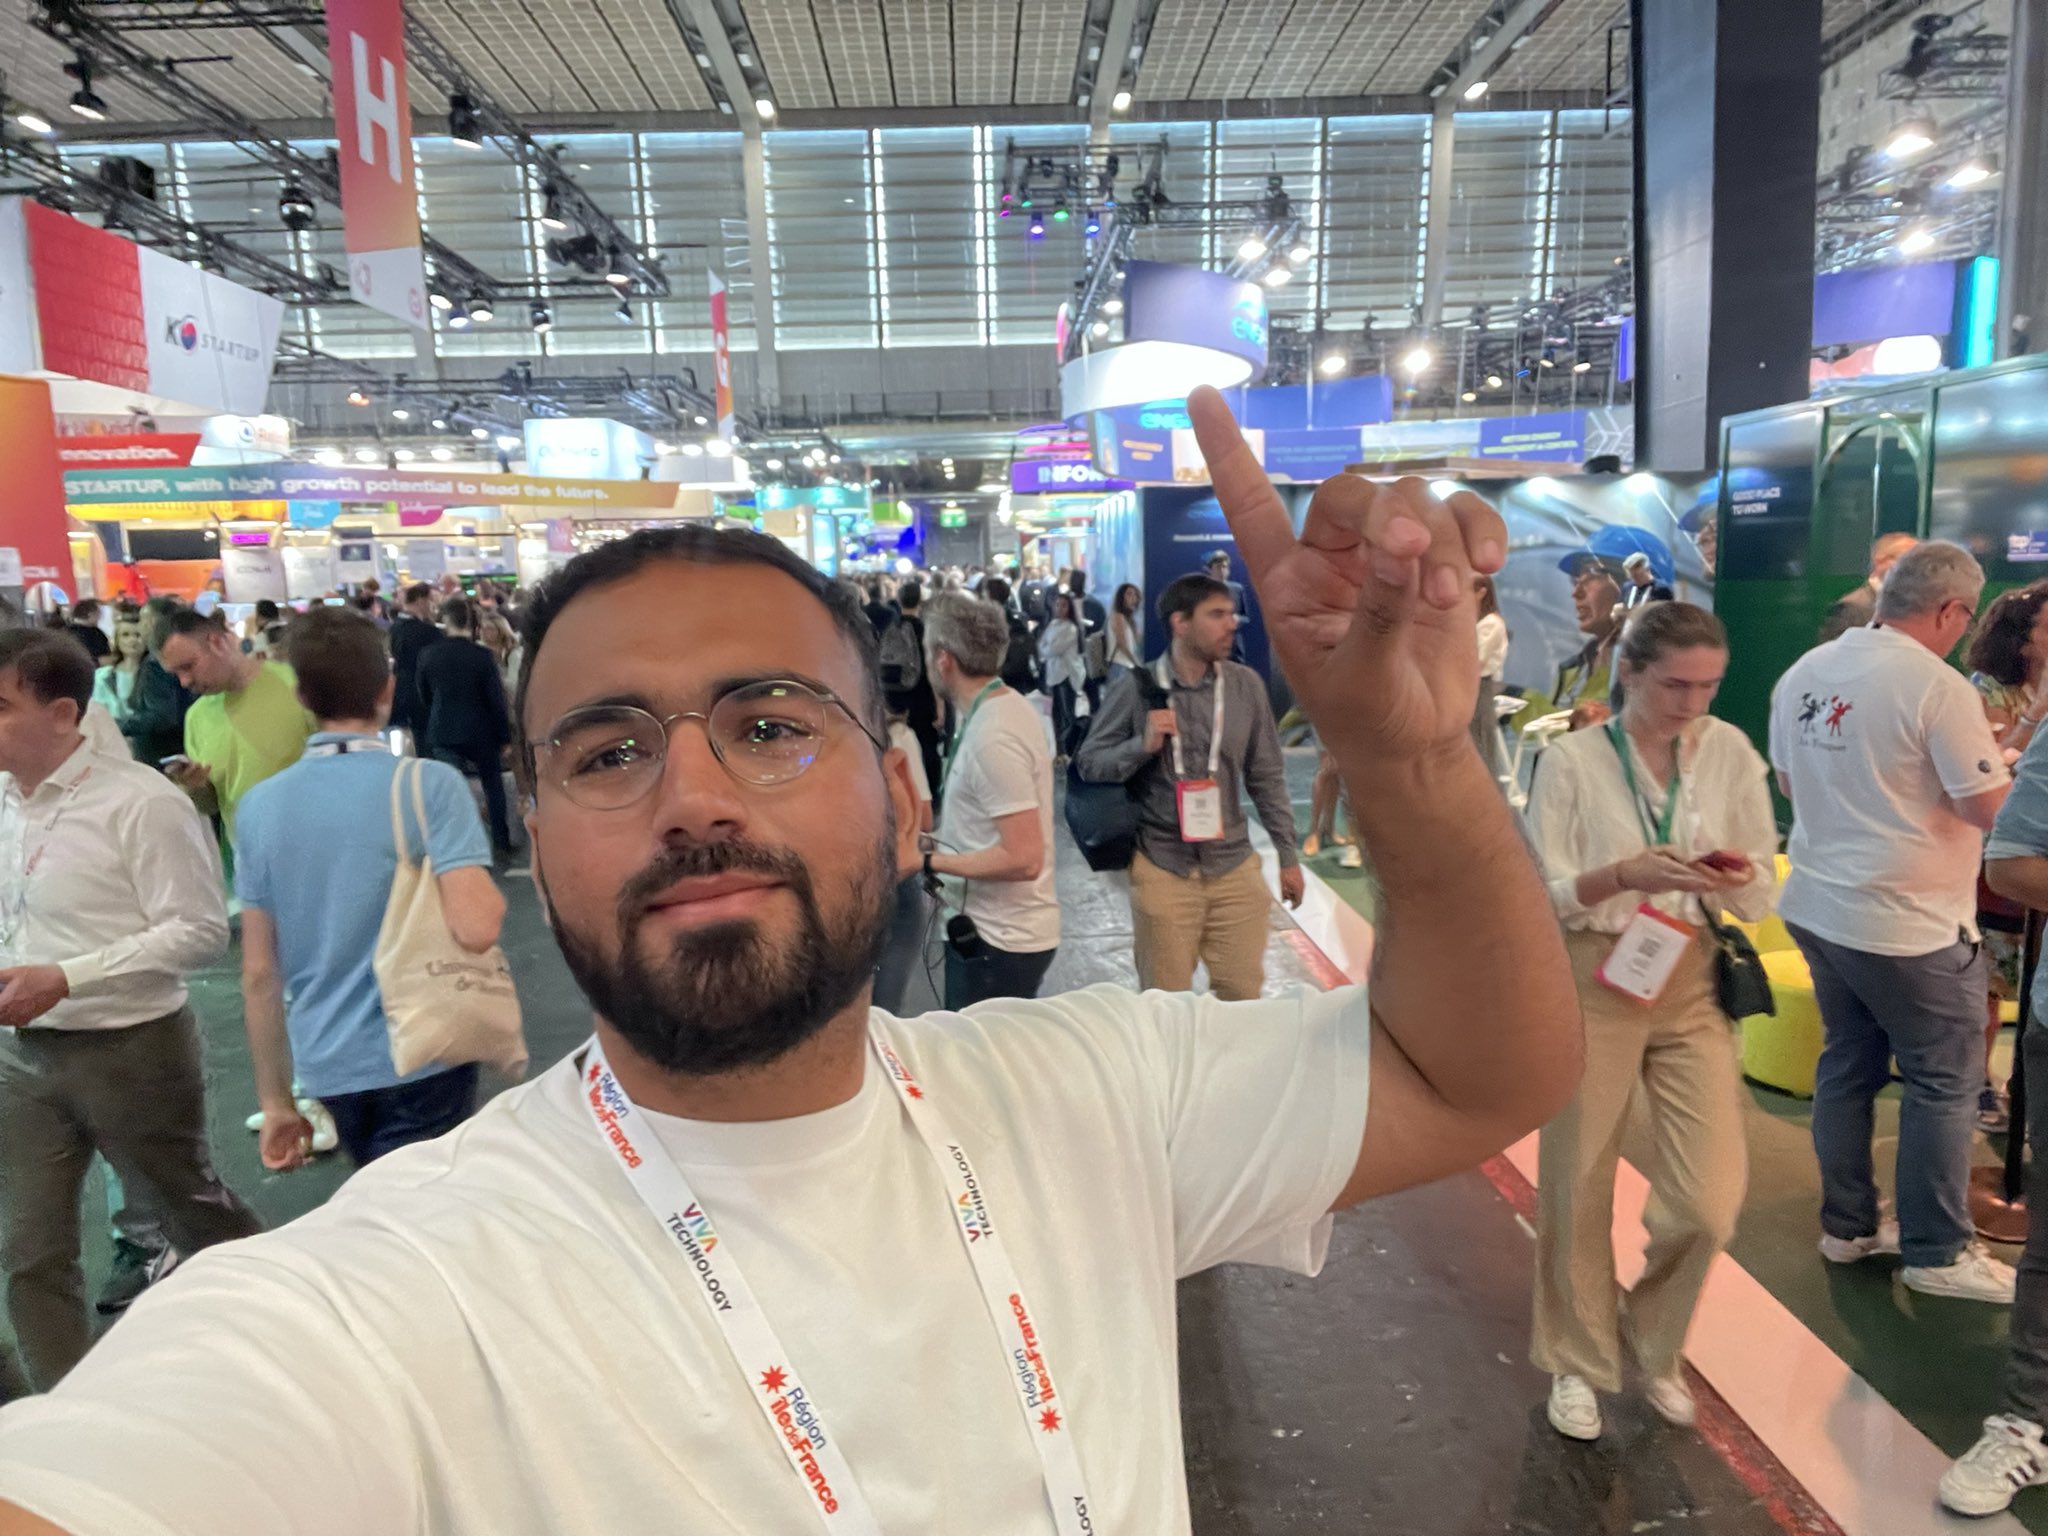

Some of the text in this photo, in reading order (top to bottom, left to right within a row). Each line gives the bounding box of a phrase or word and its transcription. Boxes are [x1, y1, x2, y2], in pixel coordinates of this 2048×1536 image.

[350, 31, 402, 184] H
[175, 478, 223, 492] with
[229, 476, 276, 494] high
[281, 477, 360, 494] growth
[365, 479, 452, 495] potential
[457, 482, 477, 494] to
[481, 483, 519, 496] lead
[524, 484, 550, 497] the
[556, 485, 609, 500] future.
[947, 1145, 994, 1239] TECHNOLOGY
[958, 1193, 980, 1243] VIVA
[683, 1202, 718, 1253] VIVA
[667, 1212, 732, 1312] TECHNOLOGY
[1014, 1348, 1042, 1408] Région
[787, 1387, 827, 1450] Région
